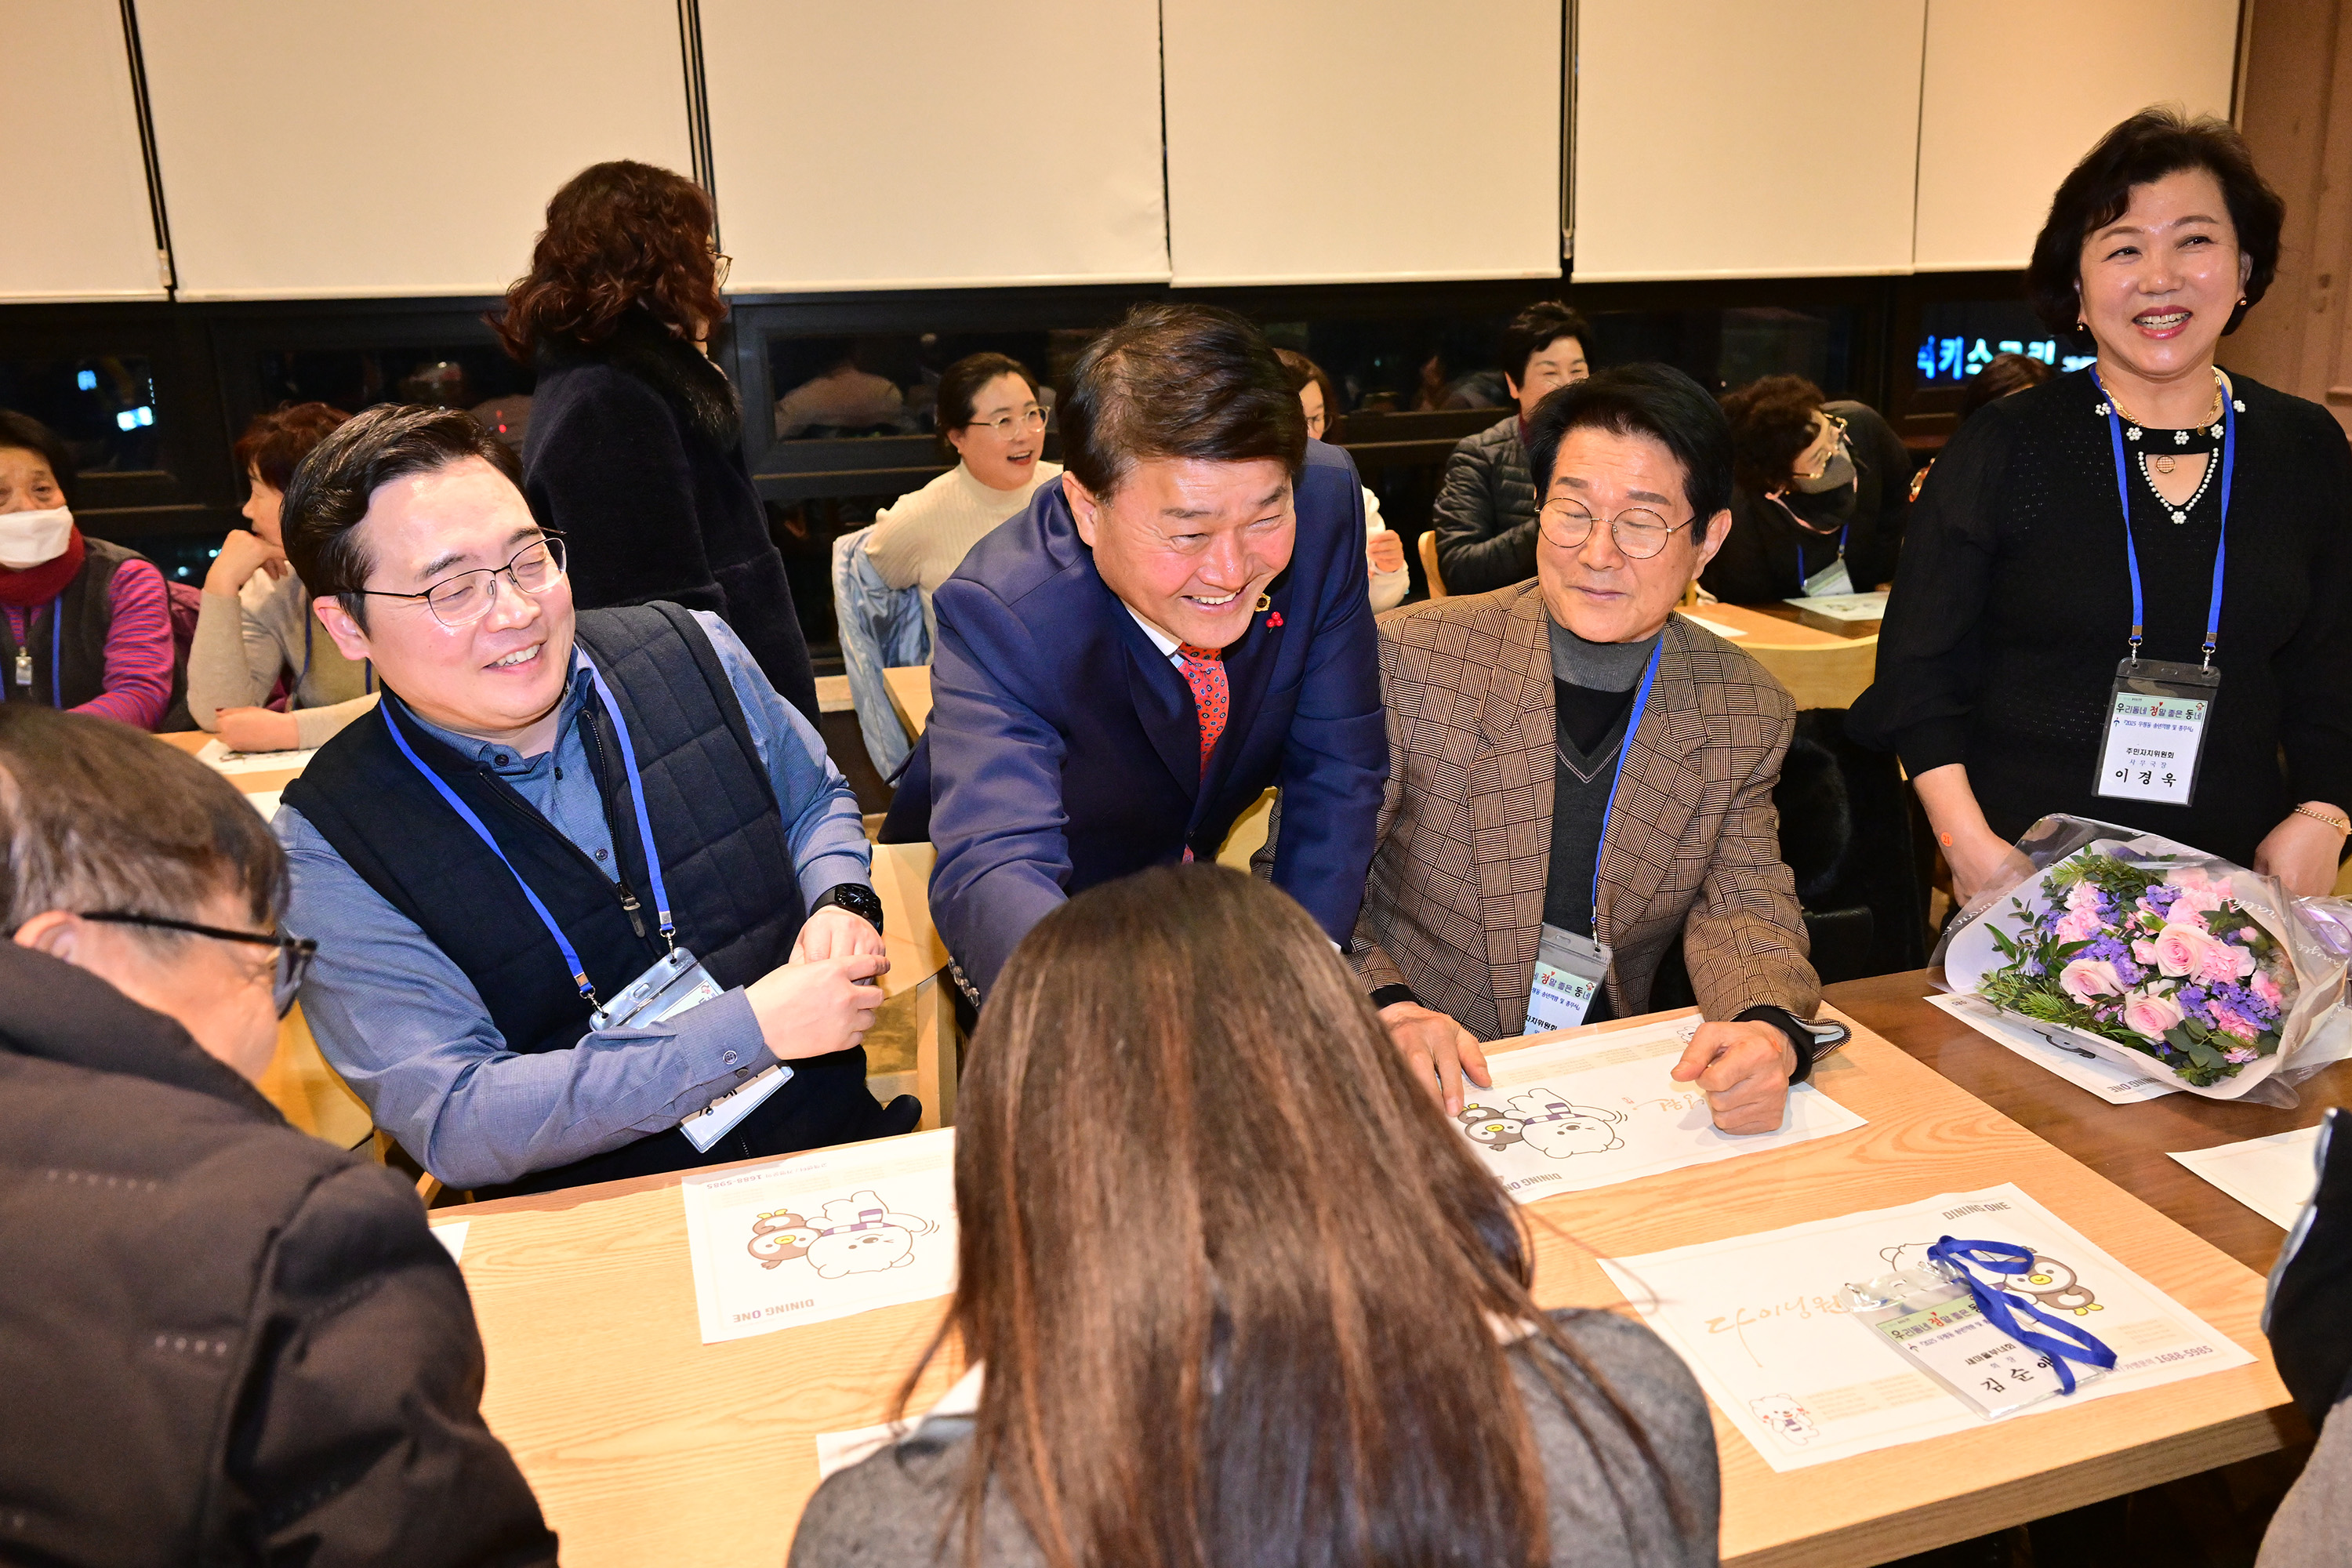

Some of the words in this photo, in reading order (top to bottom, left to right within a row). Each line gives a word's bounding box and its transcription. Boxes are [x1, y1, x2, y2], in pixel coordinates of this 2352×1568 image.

[2116, 703, 2147, 715] 우리동네
[2150, 706, 2166, 717] 정말
[2185, 710, 2201, 720] 동네
[2126, 747, 2174, 759] 주민자치위원회
[1541, 973, 1557, 987] 정말
[1574, 986, 1592, 1000] 동네
[2107, 1083, 2132, 1093] ONE
[706, 1174, 762, 1189] 1688-5985
[1502, 1181, 1521, 1192] ON
[1520, 1173, 1563, 1186] DINING
[1941, 1204, 1987, 1220] DINING
[1984, 1202, 2012, 1211] ONE
[765, 1299, 815, 1316] DINING
[732, 1310, 761, 1323] ONE
[1892, 1323, 1933, 1340] 우리동네
[1928, 1316, 1954, 1327] 정말
[1969, 1303, 1982, 1313] 동
[1965, 1343, 2016, 1366] 새마을부녀회
[2154, 1345, 2214, 1363] 1688-5985
